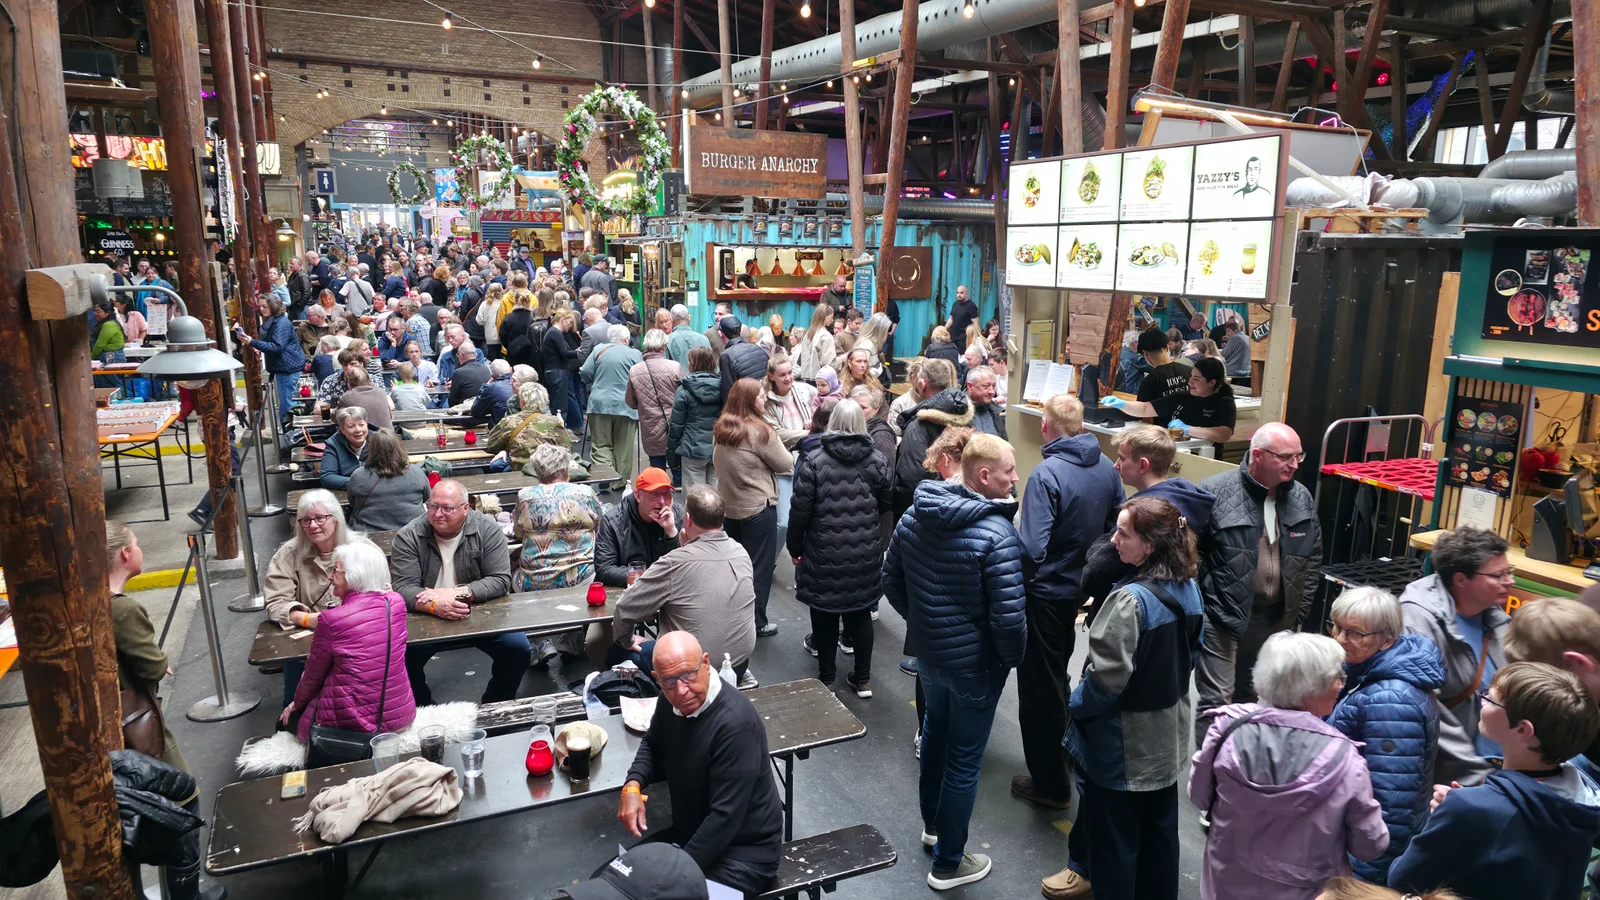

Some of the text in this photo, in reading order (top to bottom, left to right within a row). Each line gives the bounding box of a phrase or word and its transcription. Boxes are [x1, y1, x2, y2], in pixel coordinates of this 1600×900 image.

[701, 152, 819, 174] BURGER ANARCHY
[1197, 171, 1240, 183] YAZZY'S
[100, 238, 135, 249] GUINNESS
[1166, 375, 1187, 387] 100%
